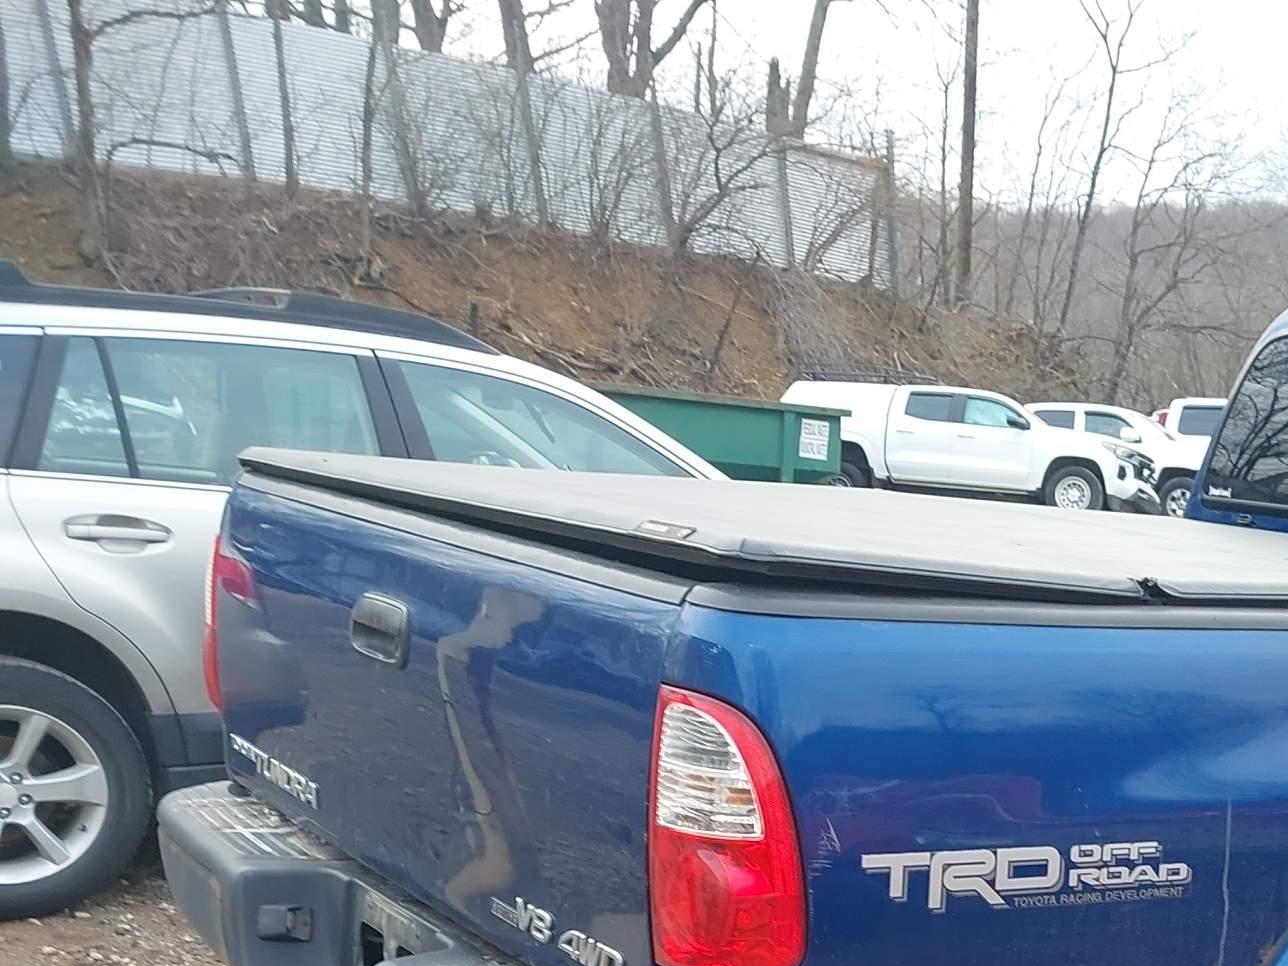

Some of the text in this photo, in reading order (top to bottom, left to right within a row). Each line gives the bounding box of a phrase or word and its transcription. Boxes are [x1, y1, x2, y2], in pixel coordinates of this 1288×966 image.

[255, 749, 318, 810] TUNDRA
[1069, 841, 1162, 866] OFF
[861, 845, 1064, 911] TRD
[1068, 862, 1190, 889] ROAD
[1013, 886, 1184, 908] TOYOTA RACING DEVELOPMENT
[515, 896, 553, 945] V8
